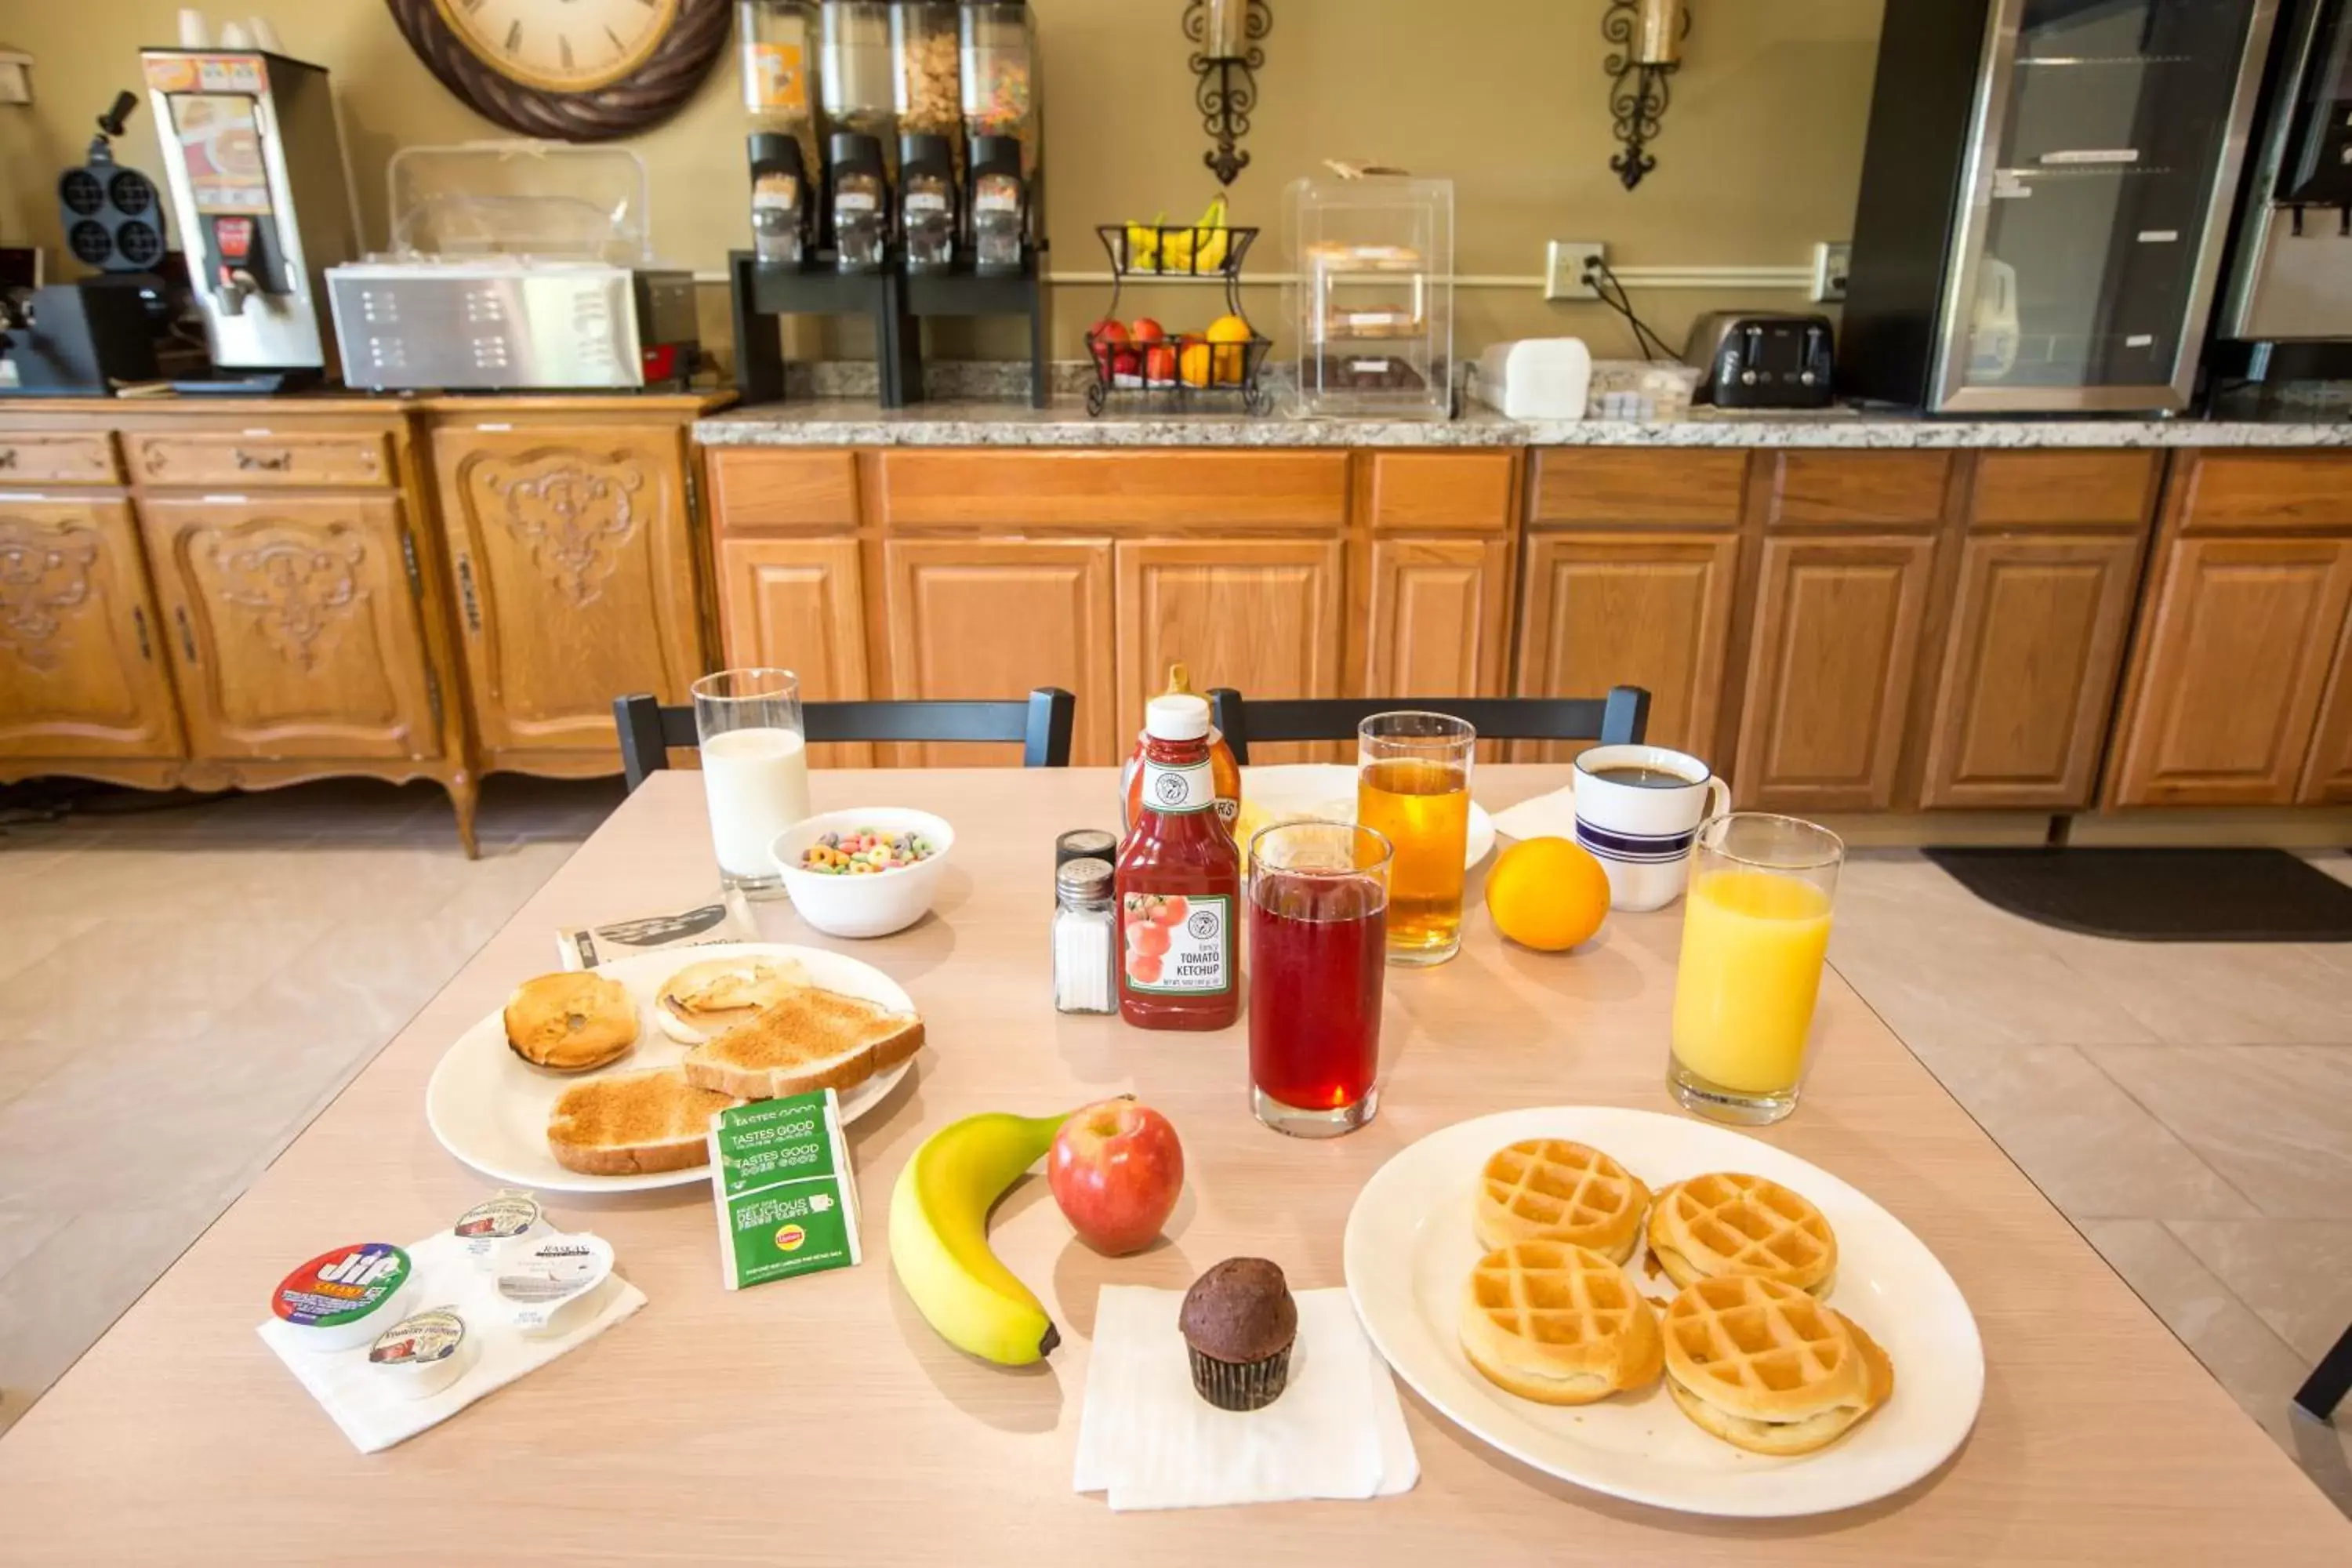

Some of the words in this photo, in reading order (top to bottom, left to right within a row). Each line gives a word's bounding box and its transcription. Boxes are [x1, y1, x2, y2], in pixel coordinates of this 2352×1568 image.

[1177, 964, 1219, 976] KETCHUP
[1181, 952, 1219, 964] TOMATO
[731, 1128, 775, 1146] TASTES
[777, 1120, 815, 1136] GOOD
[737, 1150, 779, 1169] TASTES
[780, 1143, 819, 1158] GOOD
[737, 1198, 807, 1223] DELICIOUS
[317, 1250, 401, 1286] Jif
